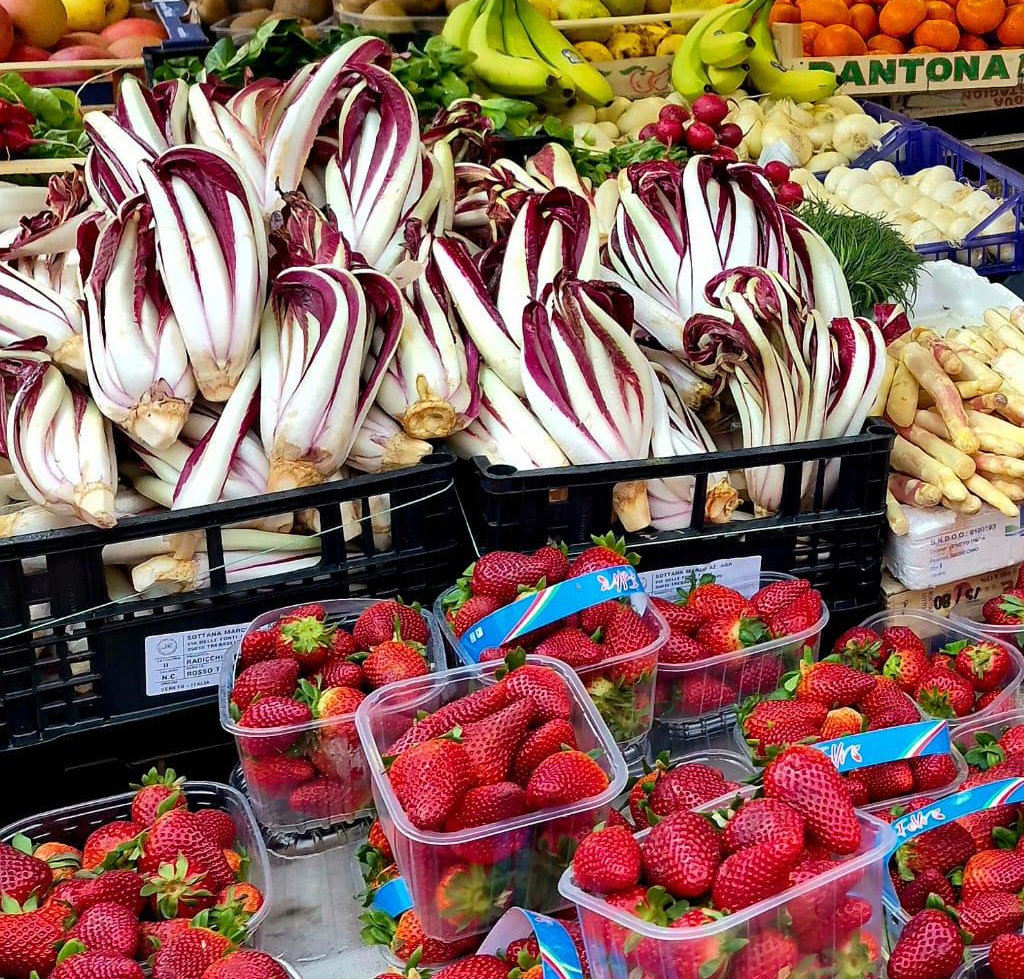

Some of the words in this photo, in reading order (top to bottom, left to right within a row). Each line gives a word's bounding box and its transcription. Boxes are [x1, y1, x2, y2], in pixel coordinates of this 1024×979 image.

[187, 631, 222, 641] SOTTANA
[186, 654, 224, 666] RADICCHI
[186, 667, 213, 677] ROSSO
[160, 683, 185, 693] VENETO
